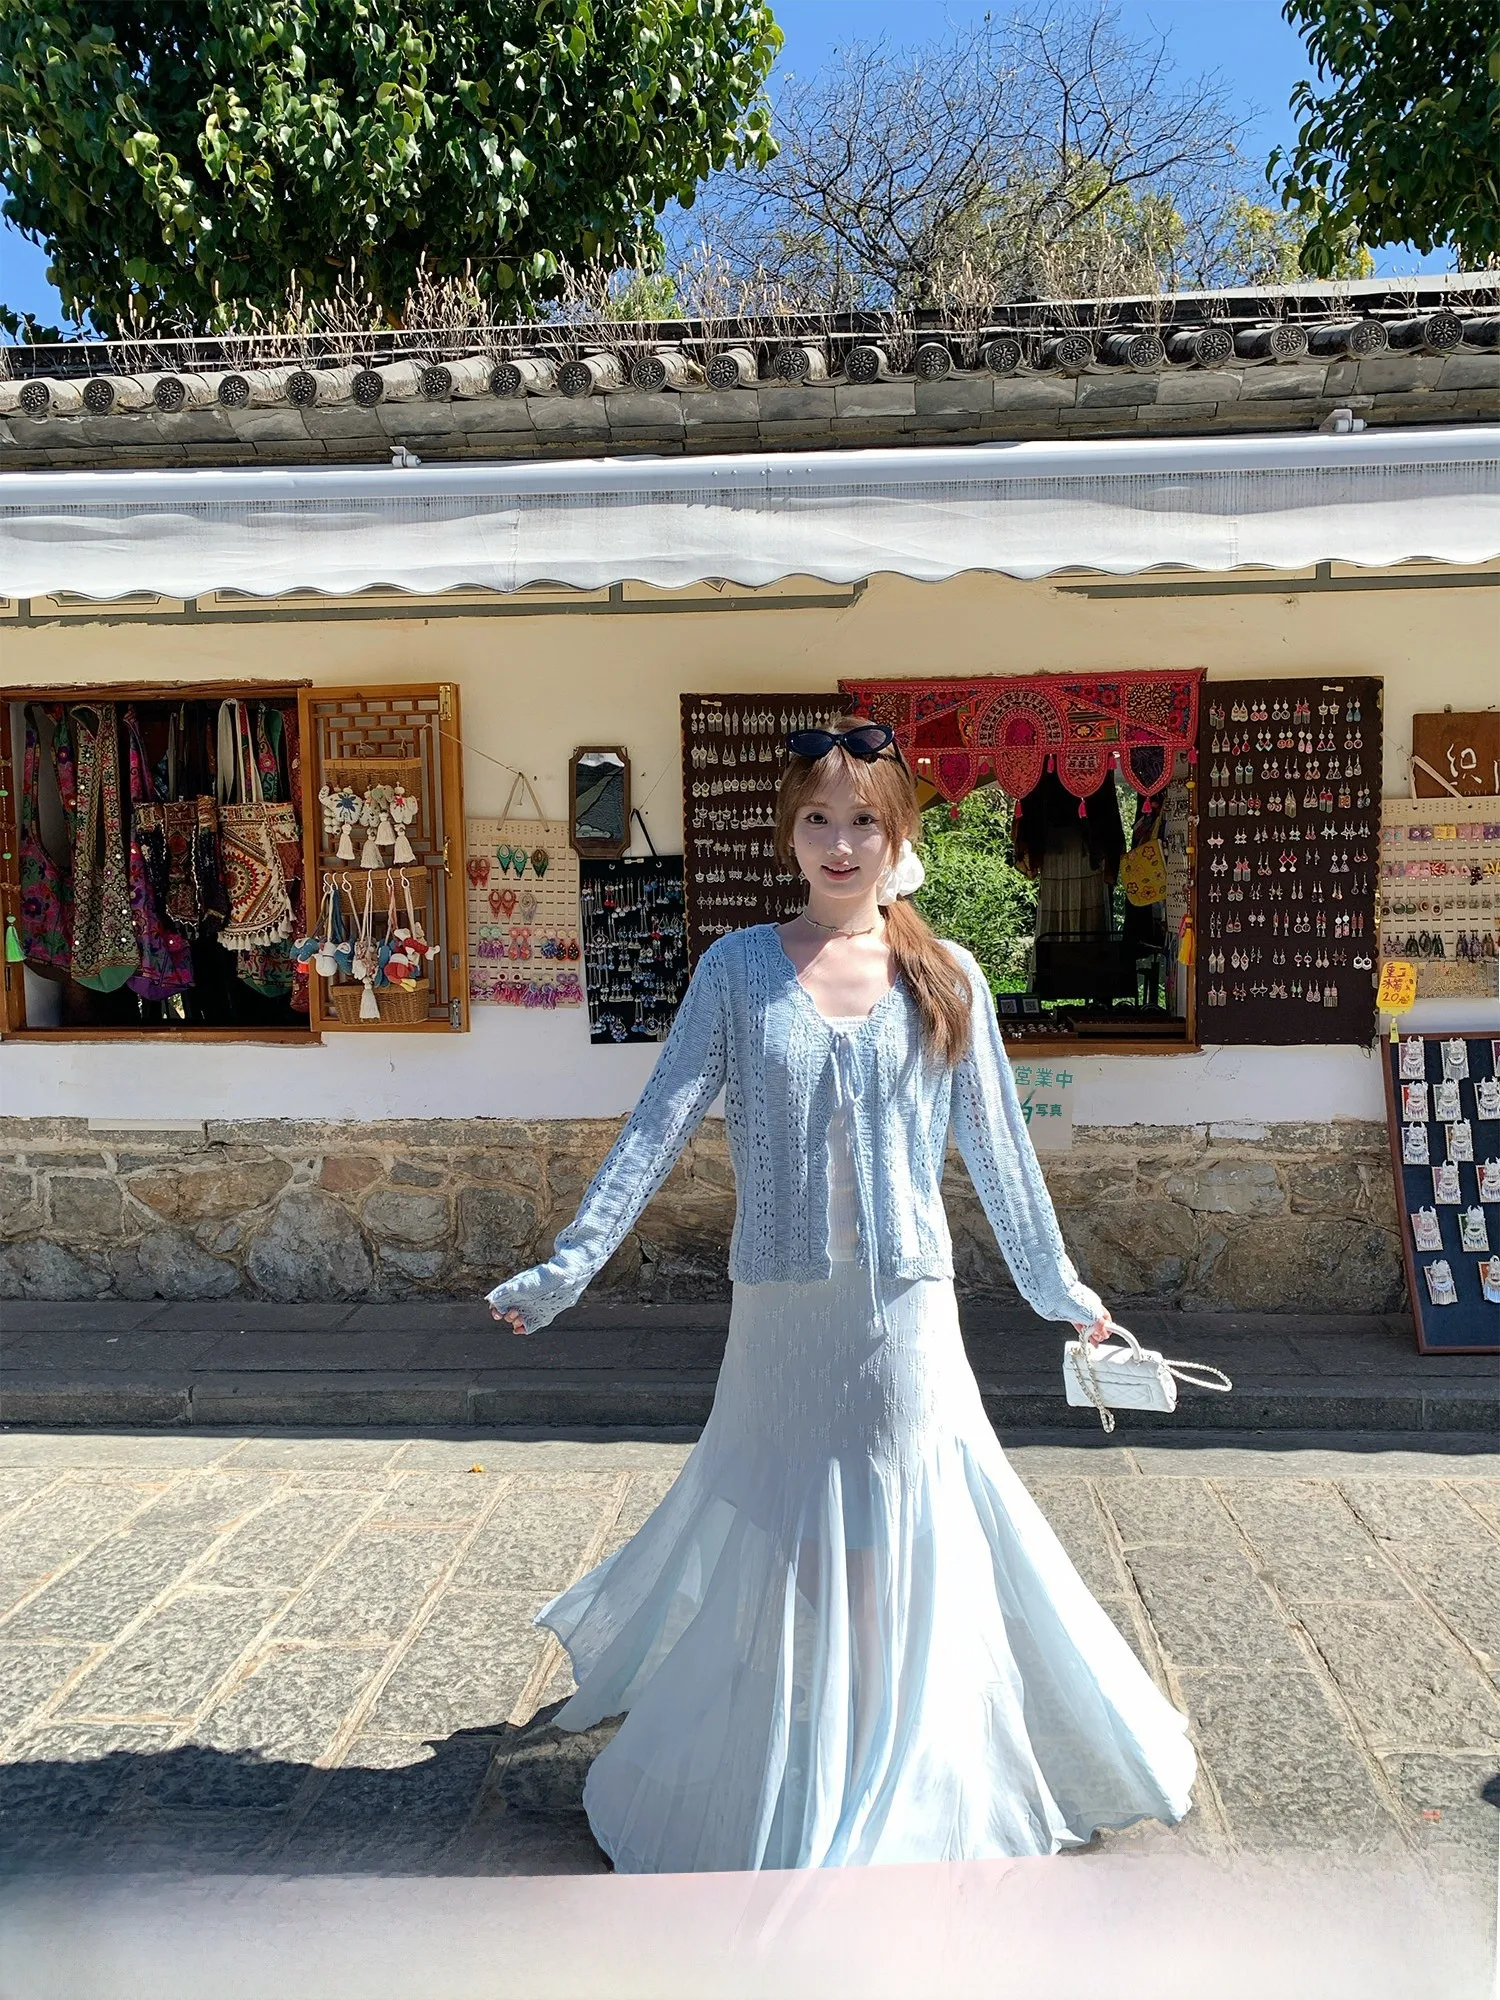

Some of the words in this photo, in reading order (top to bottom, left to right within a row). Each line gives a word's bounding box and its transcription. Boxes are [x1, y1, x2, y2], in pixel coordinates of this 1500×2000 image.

[1446, 743, 1500, 795] 织
[1015, 1065, 1073, 1089] 営業中
